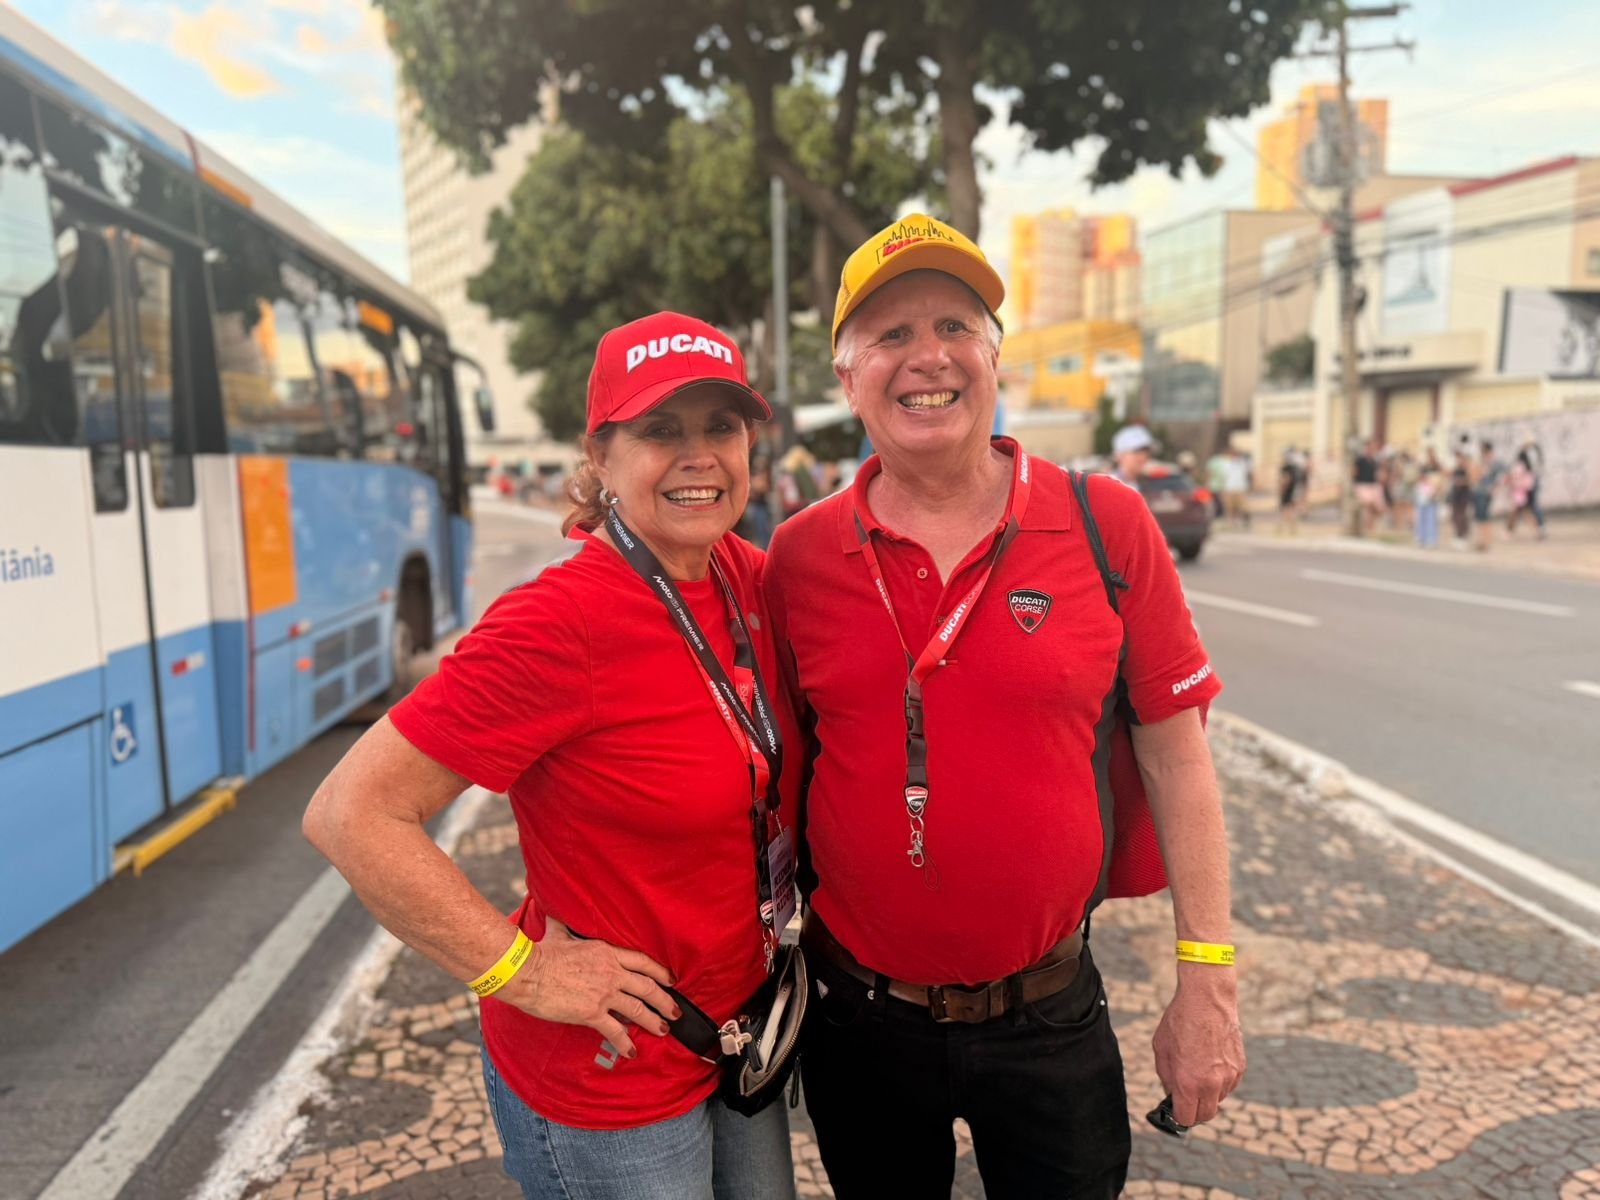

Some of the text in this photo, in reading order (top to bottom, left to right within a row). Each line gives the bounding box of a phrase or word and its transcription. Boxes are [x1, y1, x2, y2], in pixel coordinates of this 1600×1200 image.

[626, 333, 733, 373] DUCATI
[612, 518, 635, 551] PREMIER
[1011, 595, 1047, 607] DUCATI
[1014, 603, 1043, 615] CORSE
[675, 607, 705, 652] PREMIER
[939, 603, 967, 642] DUCATI
[709, 680, 732, 721] DUCATI
